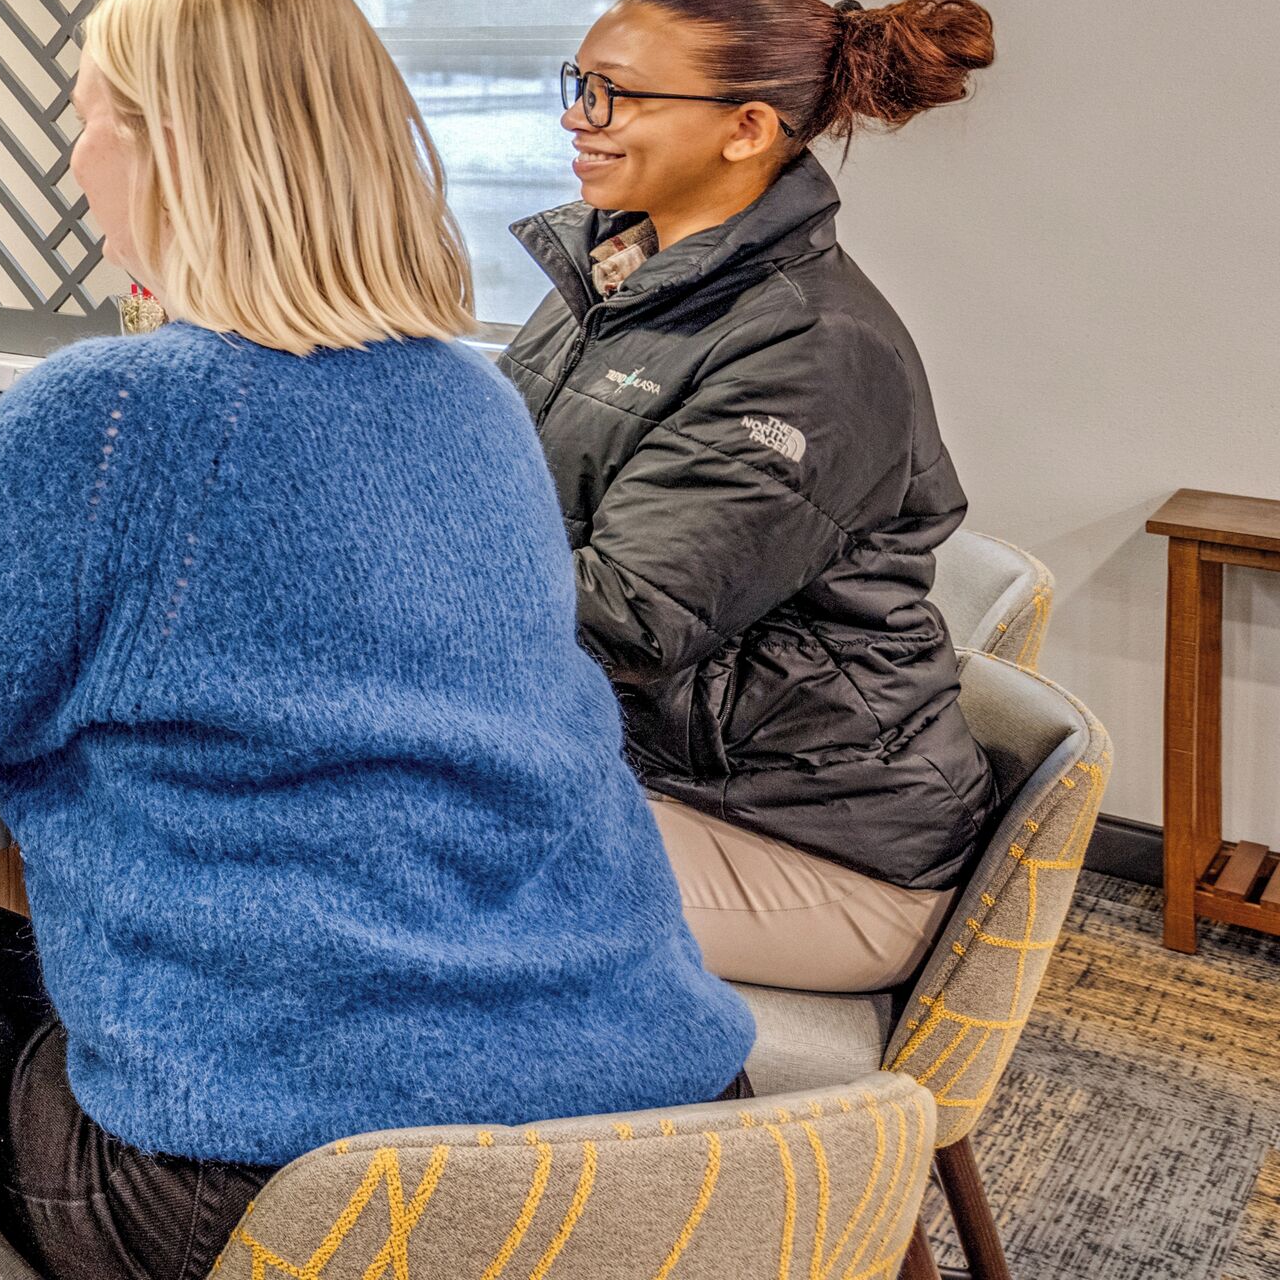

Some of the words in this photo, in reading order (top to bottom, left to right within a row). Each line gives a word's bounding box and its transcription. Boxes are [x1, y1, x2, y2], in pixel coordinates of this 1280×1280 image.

[740, 415, 790, 446] NORTH
[767, 414, 794, 435] THE
[748, 429, 785, 453] FACE
